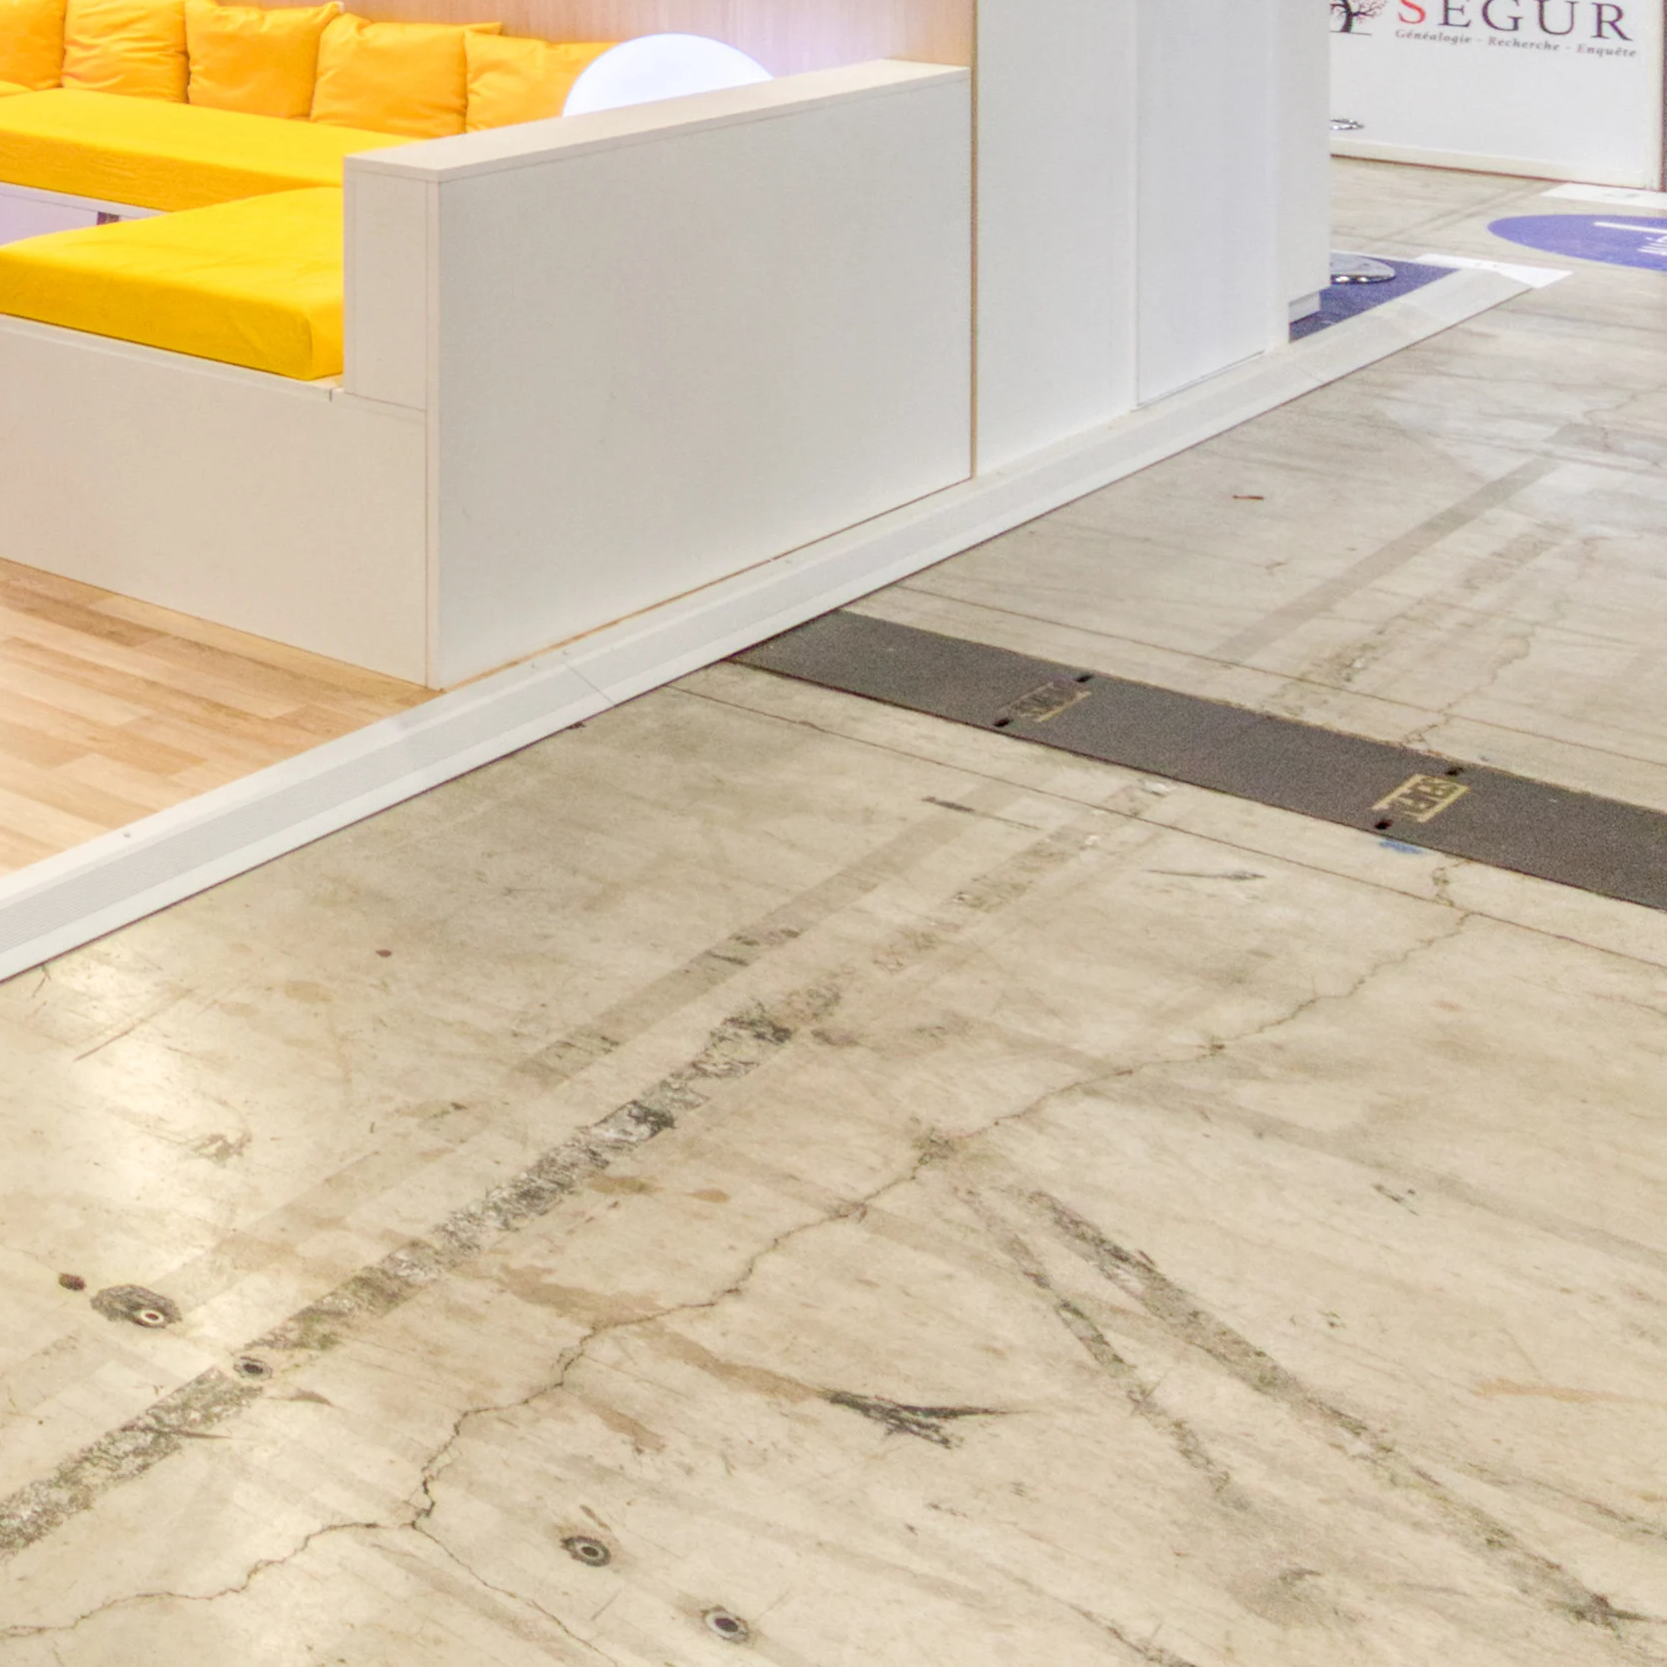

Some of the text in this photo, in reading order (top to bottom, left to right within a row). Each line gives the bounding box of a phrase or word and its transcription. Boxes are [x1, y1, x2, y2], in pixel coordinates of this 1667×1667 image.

[1395, 27, 1472, 46] Généalogie
[1487, 36, 1561, 52] Recherche
[1576, 43, 1637, 59] Enquête
